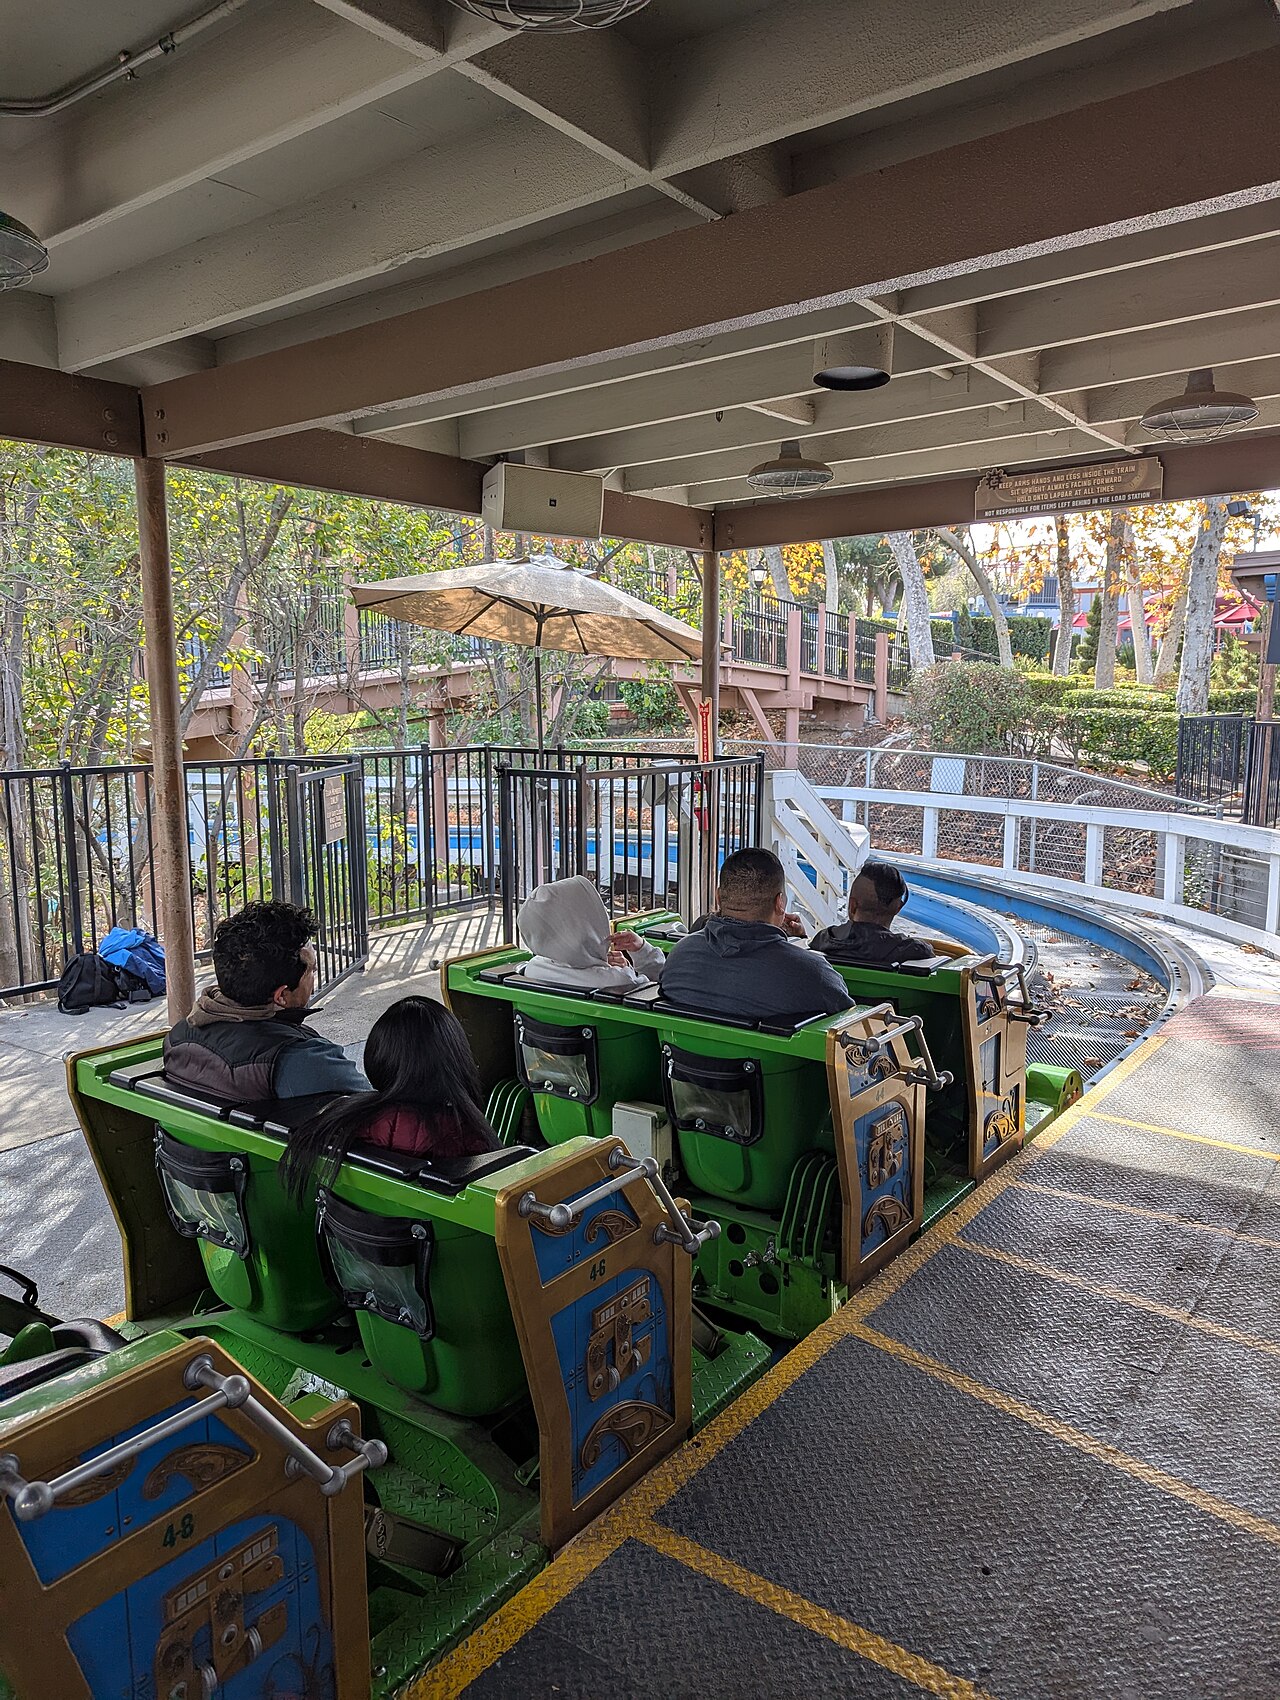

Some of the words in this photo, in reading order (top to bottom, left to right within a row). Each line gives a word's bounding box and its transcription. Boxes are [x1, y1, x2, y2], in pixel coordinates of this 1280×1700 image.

[998, 482, 1013, 490] KEEP
[1032, 477, 1051, 485] HANDS
[1066, 472, 1081, 480] LEGS
[1082, 470, 1102, 478] INSIDE
[1117, 465, 1136, 474] TRAIN
[1010, 488, 1020, 496] SIT
[1021, 485, 1046, 495] UPRIGHT
[1046, 482, 1070, 491] ALWAYS
[1070, 479, 1092, 488] FACING
[1092, 476, 1122, 486] FORWARD
[996, 506, 1029, 516] RESPONSIBLE
[1072, 498, 1091, 507] BEHIND
[1111, 494, 1126, 502] LOAD
[1127, 492, 1151, 500] STATION
[1016, 495, 1032, 503] HOLD
[1032, 493, 1048, 501] ONTO
[1049, 490, 1073, 499] LAPBAR
[1096, 485, 1115, 494] TIMES
